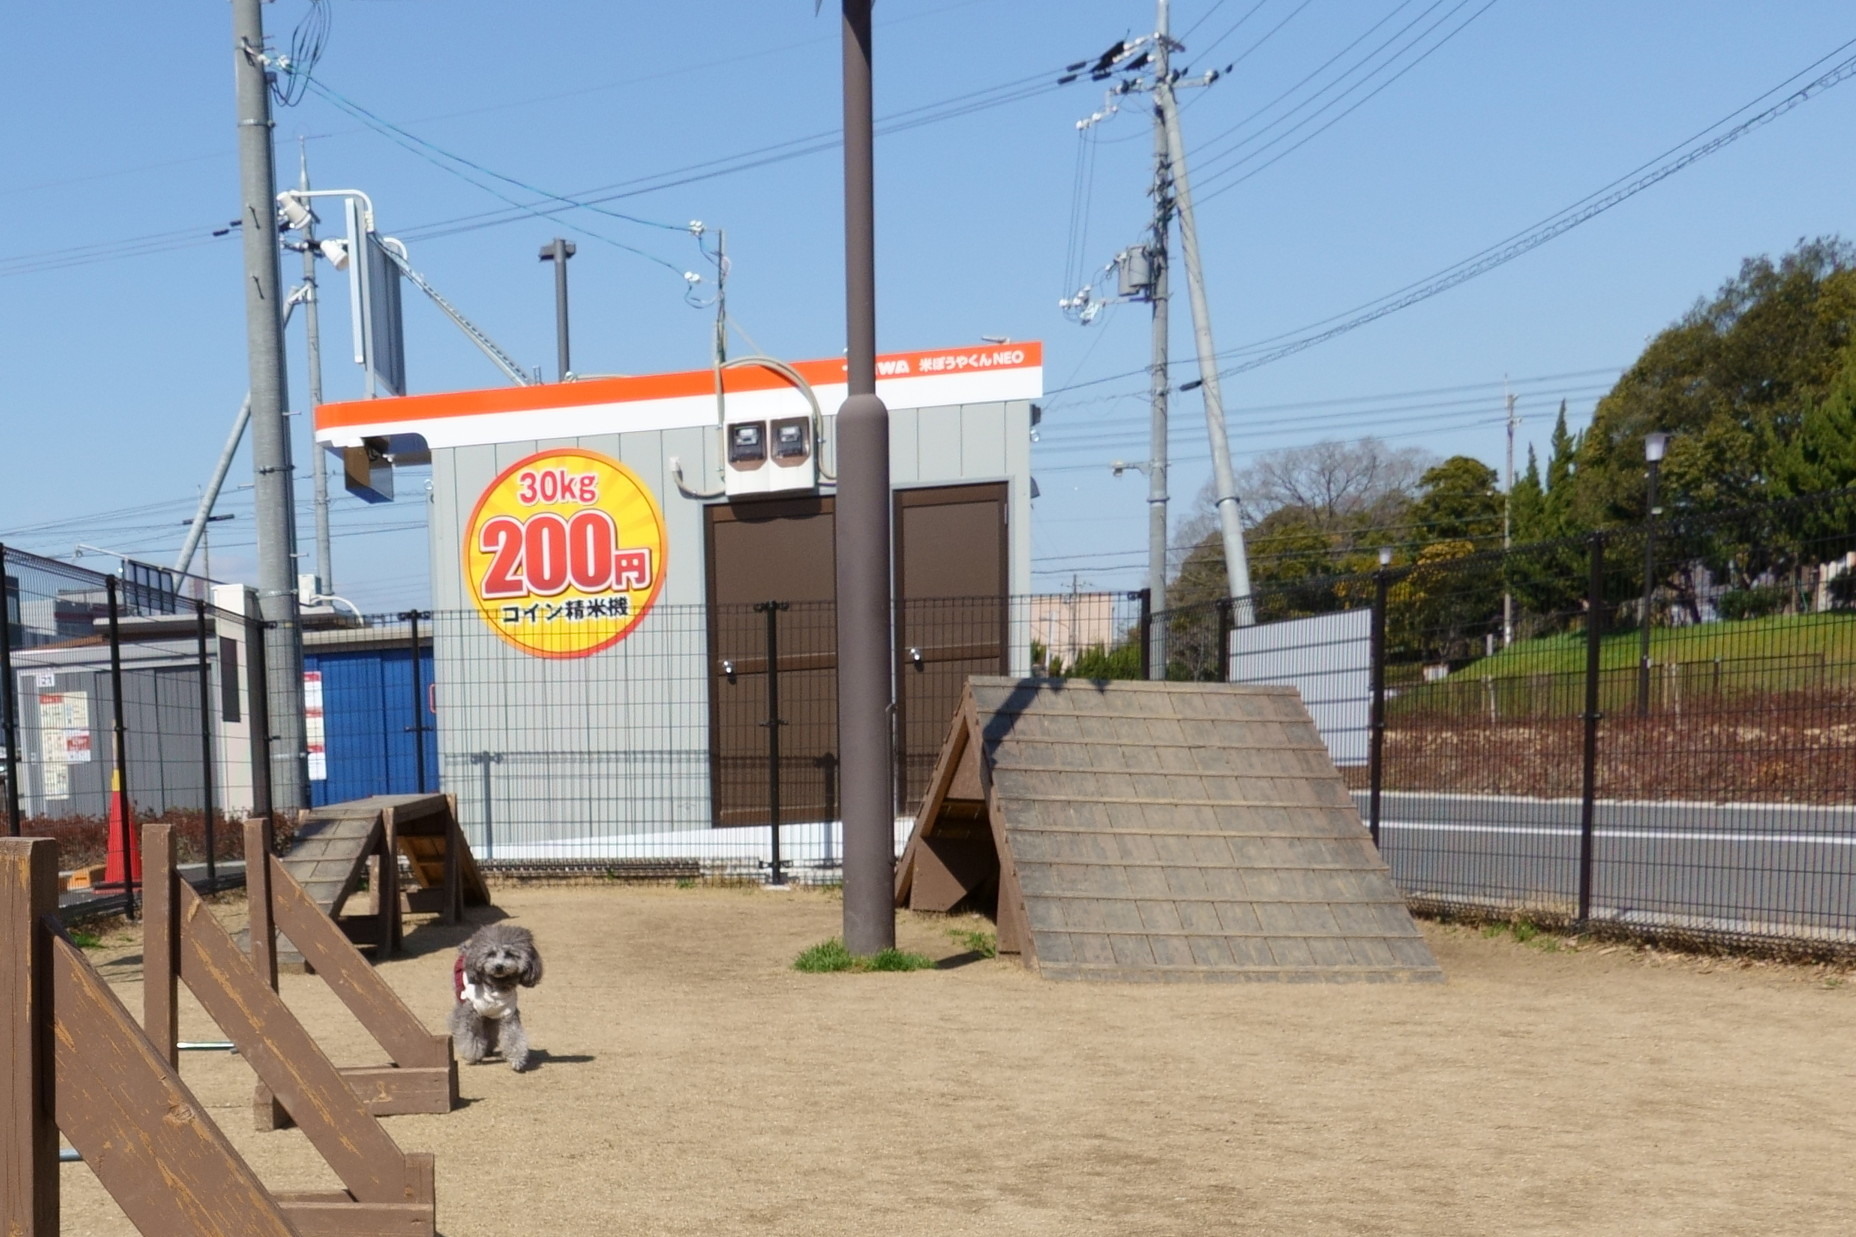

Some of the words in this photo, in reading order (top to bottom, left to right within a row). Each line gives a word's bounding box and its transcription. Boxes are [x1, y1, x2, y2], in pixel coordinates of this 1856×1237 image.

[519, 470, 597, 503] 30kg
[480, 511, 651, 600] 200円
[502, 596, 629, 624] コイン精米機
